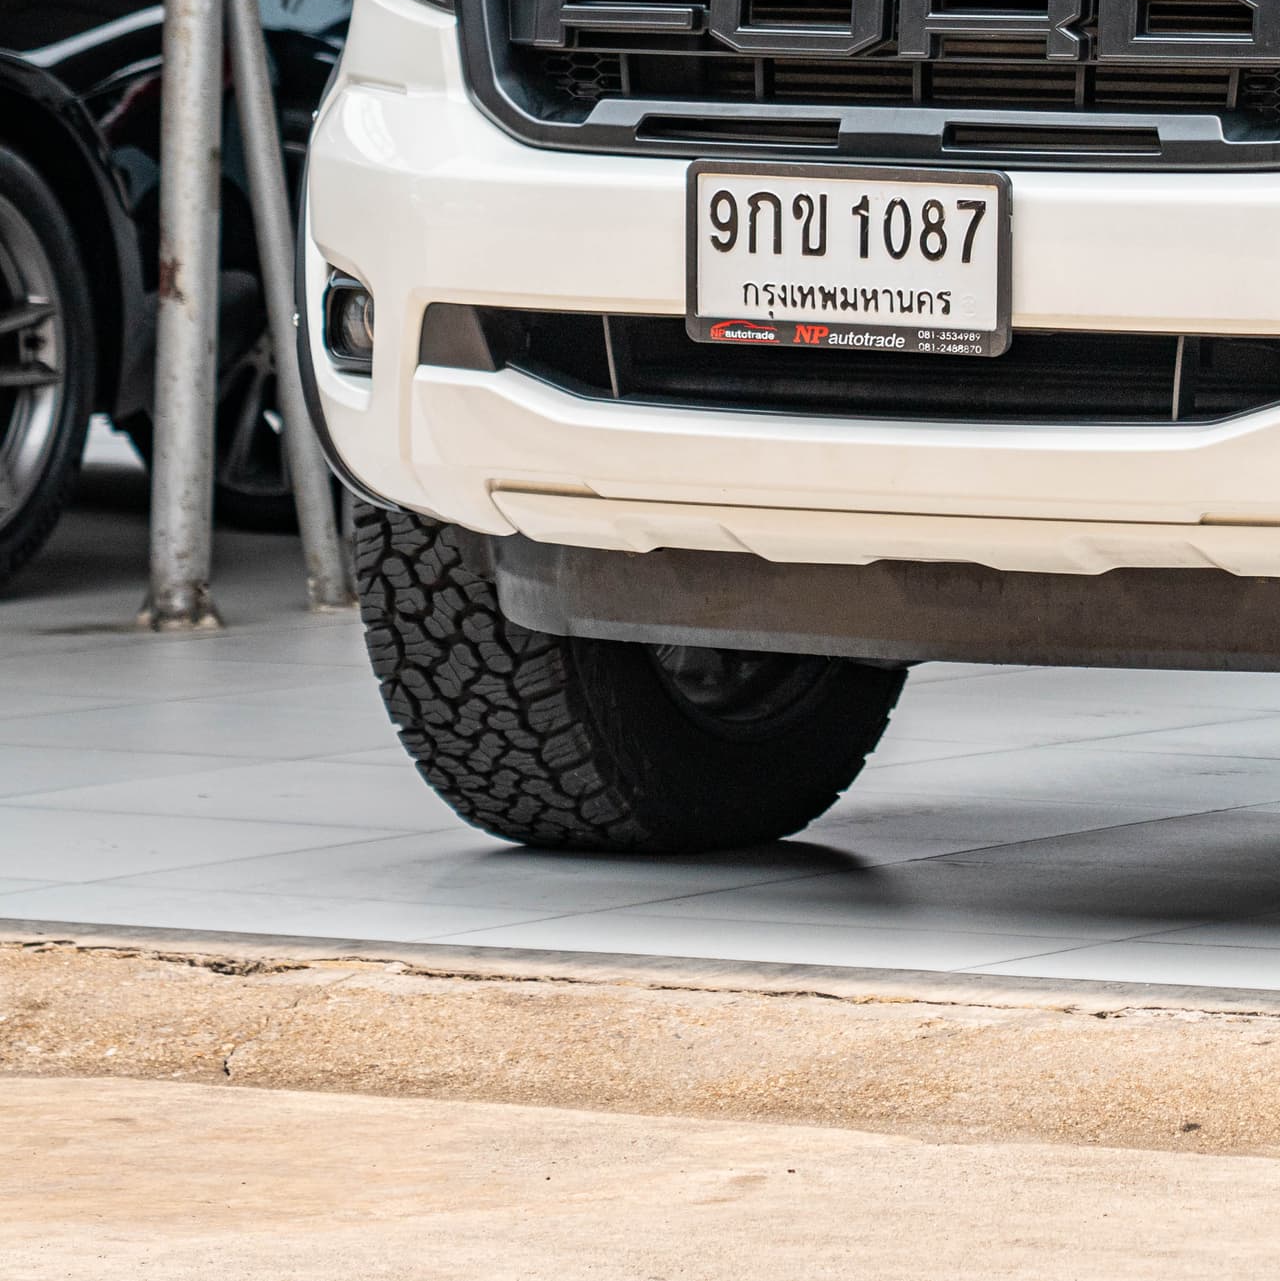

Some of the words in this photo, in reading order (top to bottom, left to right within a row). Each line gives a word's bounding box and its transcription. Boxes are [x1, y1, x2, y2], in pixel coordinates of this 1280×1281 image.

[709, 189, 828, 257] 9กข
[851, 194, 987, 264] 1087
[742, 281, 952, 319] กรุงเทพมหานคร
